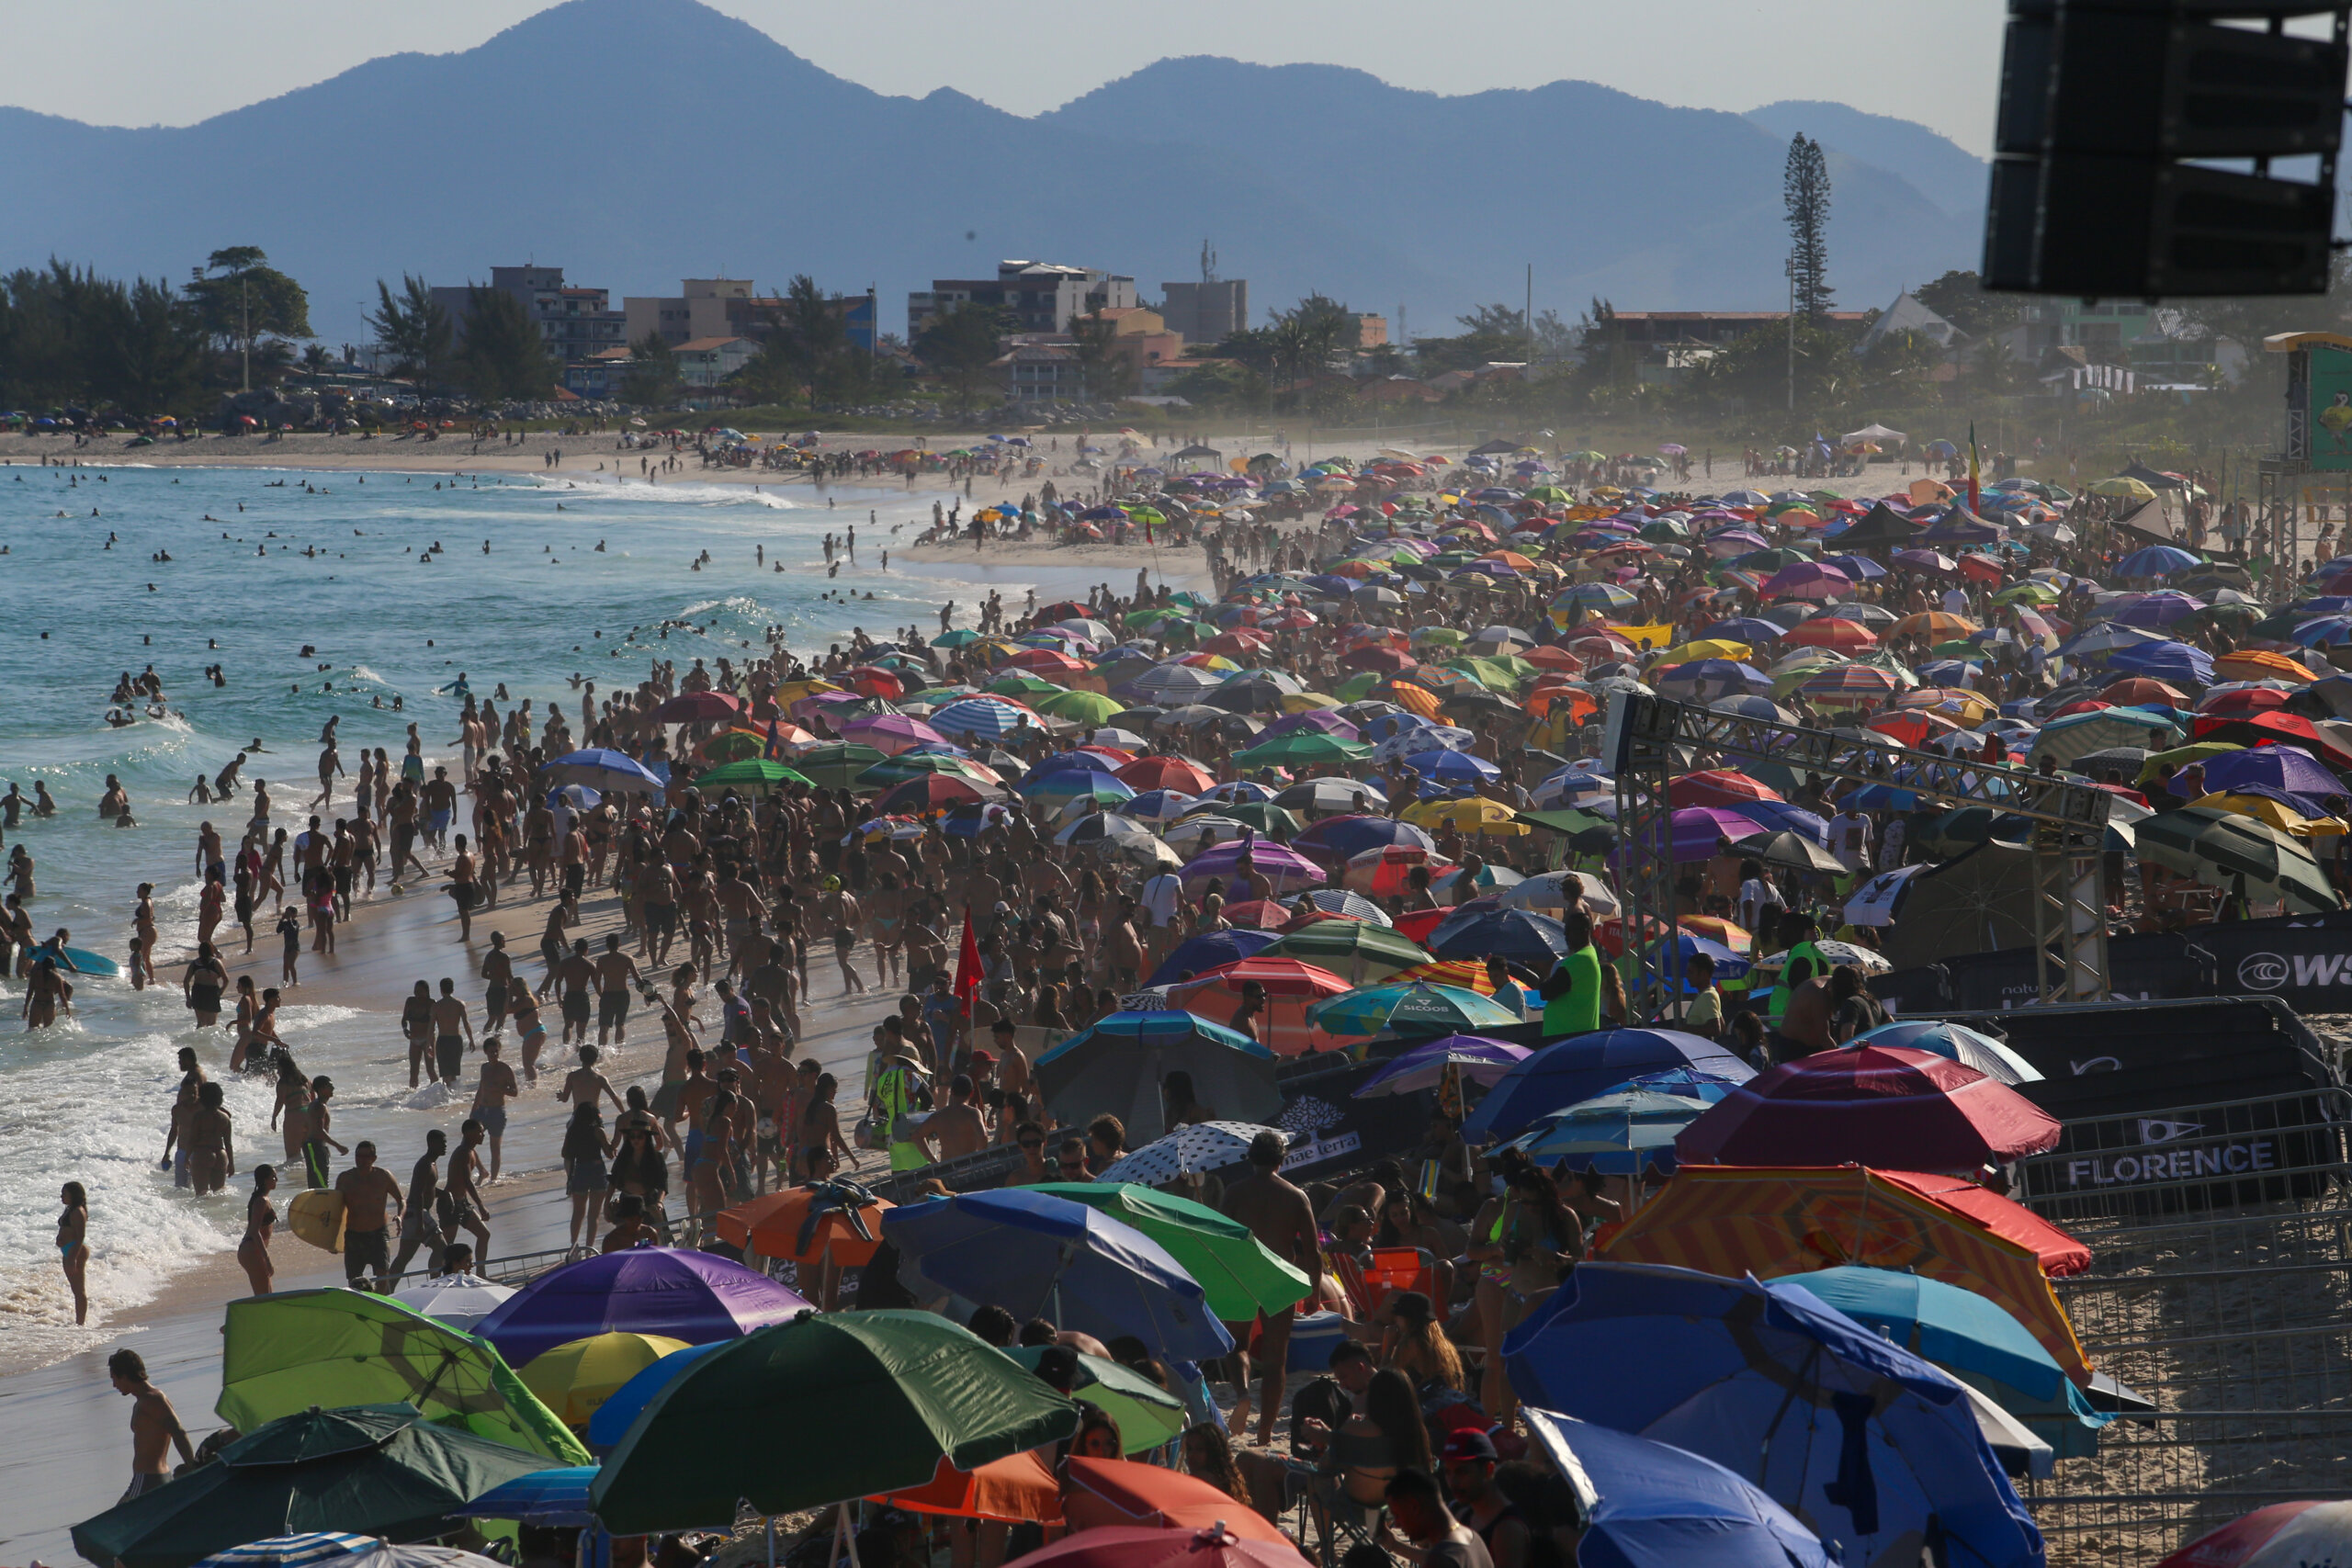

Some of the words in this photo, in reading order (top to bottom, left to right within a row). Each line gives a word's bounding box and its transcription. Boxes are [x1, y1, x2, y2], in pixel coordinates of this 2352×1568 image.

[2002, 984, 2054, 995] natua
[1404, 1005, 1449, 1013] SICOOB
[1317, 1136, 1358, 1156] terra
[2069, 1142, 2274, 1186] FLORENCE
